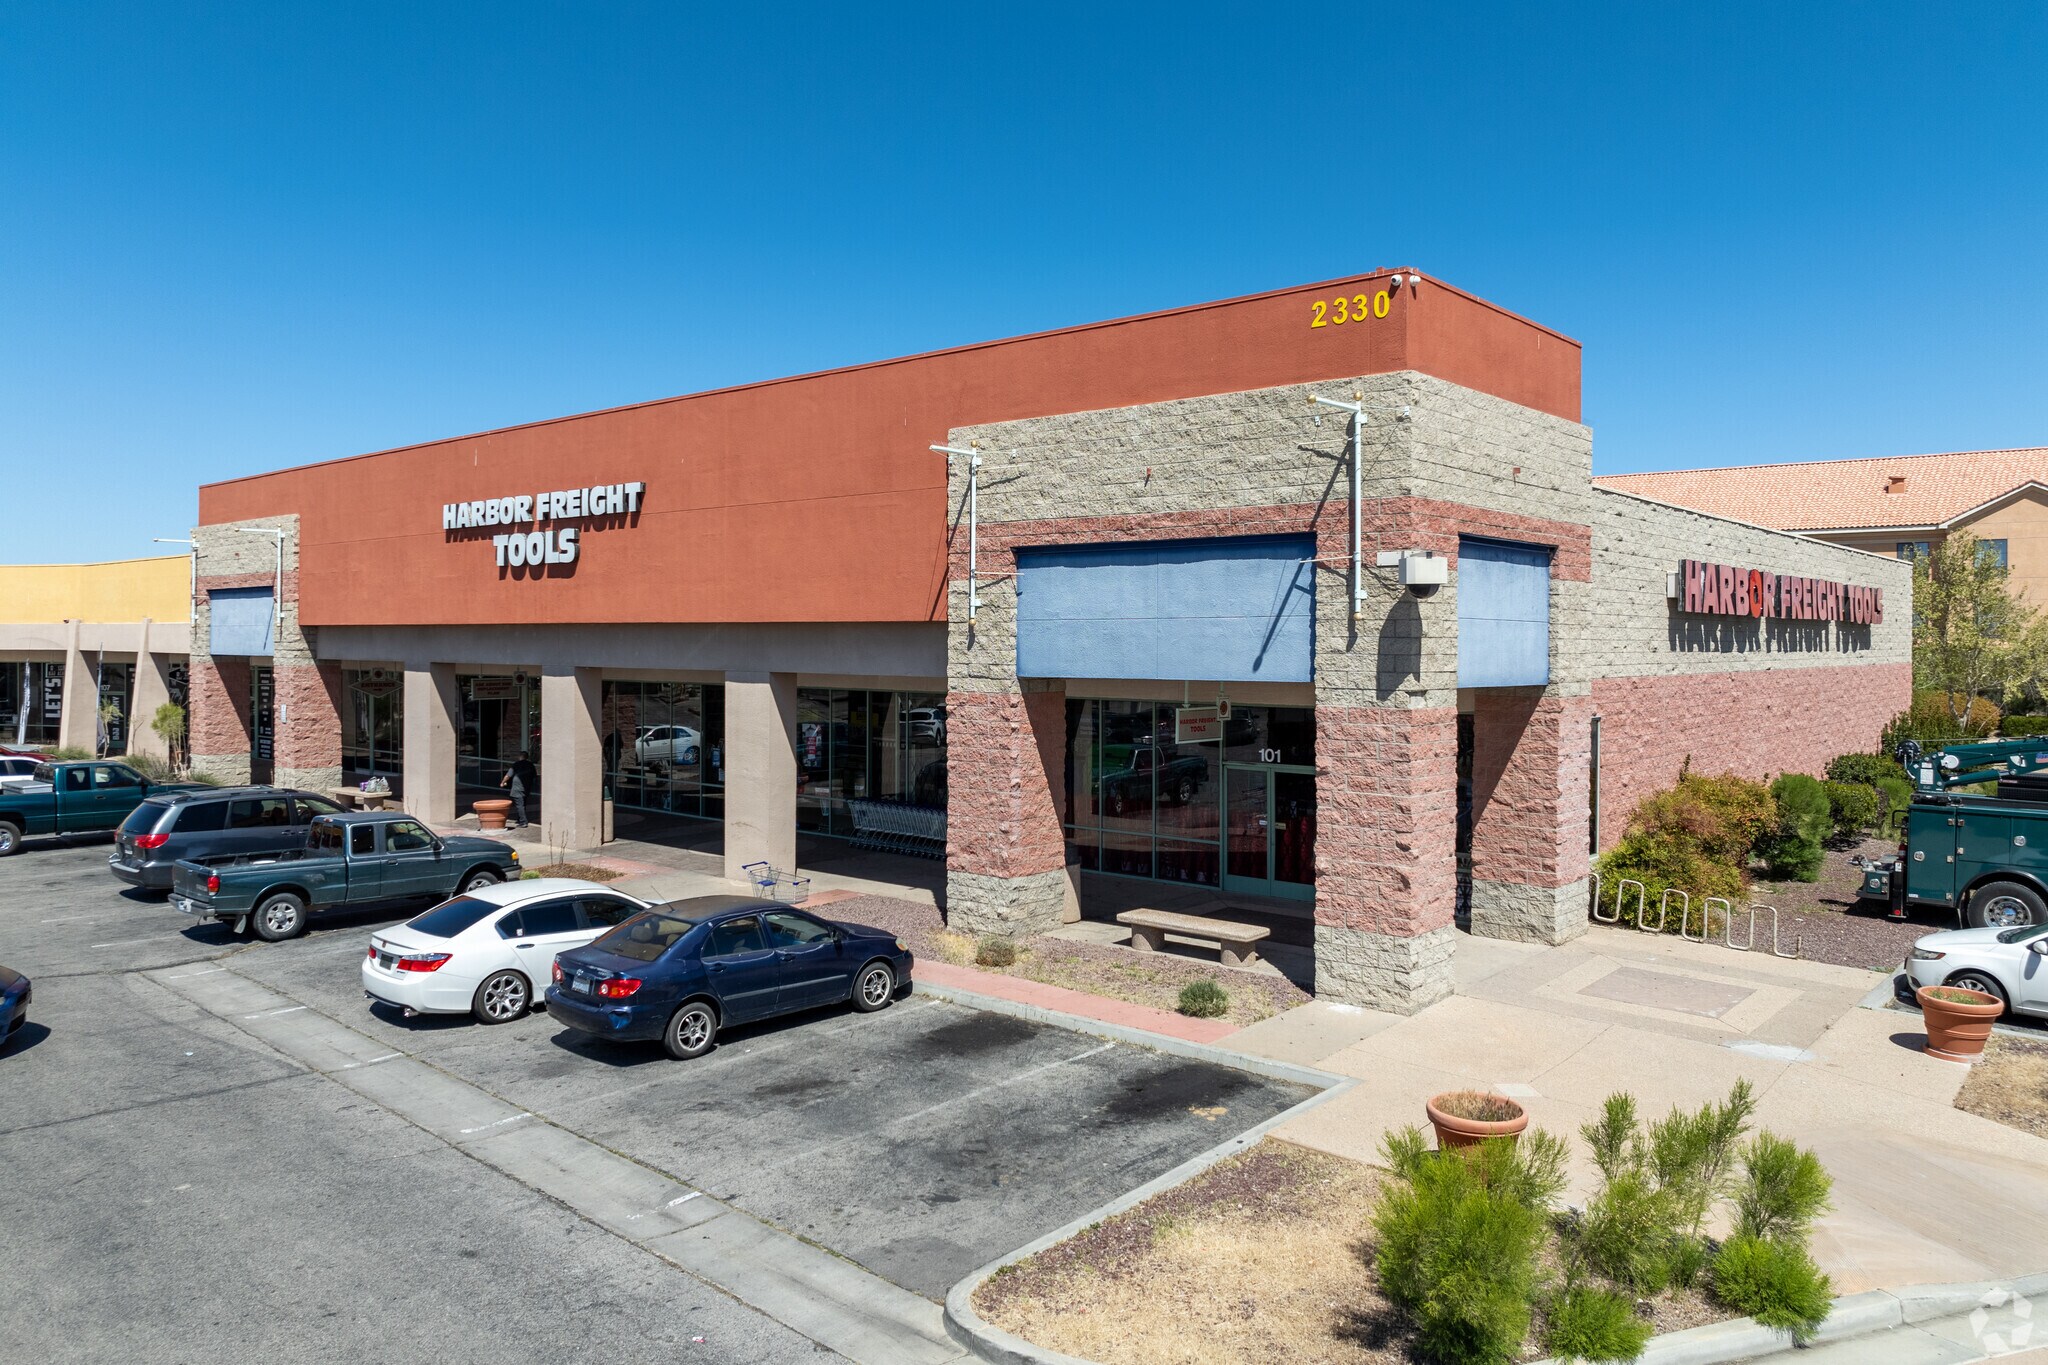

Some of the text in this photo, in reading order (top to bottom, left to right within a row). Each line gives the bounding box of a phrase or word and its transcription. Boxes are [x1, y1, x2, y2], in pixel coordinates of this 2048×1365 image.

[1311, 290, 1391, 329] 2330
[443, 482, 646, 530] HARBOR FREIGHT
[493, 528, 580, 567] TOOLS
[1680, 559, 1884, 625] HARBOR FREIGHT TOOLS
[44, 678, 62, 718] LET'S
[112, 696, 120, 725] ACAMY
[1190, 725, 1206, 733] TOOLS
[1258, 748, 1281, 763] 101
